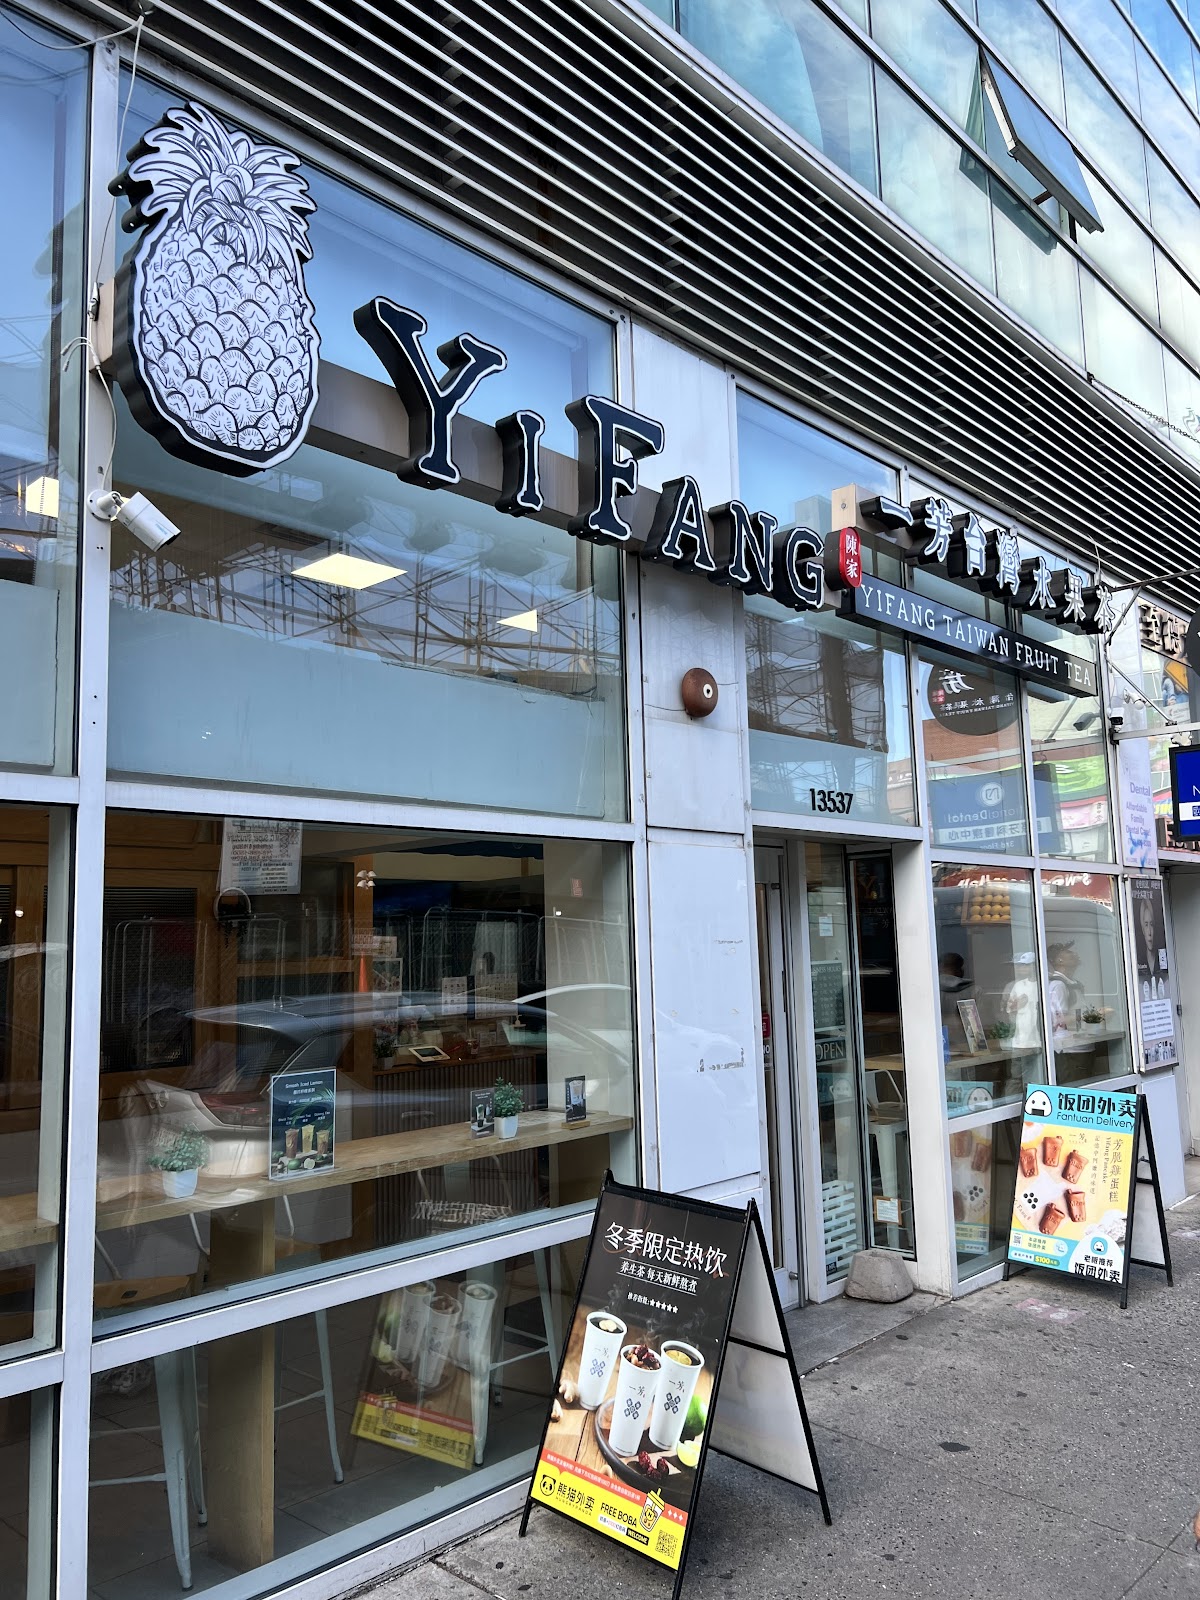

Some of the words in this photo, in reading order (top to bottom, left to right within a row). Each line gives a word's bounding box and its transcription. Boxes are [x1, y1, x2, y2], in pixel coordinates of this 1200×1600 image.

[358, 296, 825, 609] YIFANG
[844, 534, 859, 579] 陳家
[878, 496, 1114, 633] 一芳台灣水果茶
[861, 585, 936, 631] YIFANG
[942, 614, 1011, 658] TAIWAN
[1015, 642, 1059, 675] FRUIT
[1064, 660, 1093, 687] TEA
[809, 788, 854, 815] 13537
[1129, 782, 1151, 797] Dental
[1056, 1111, 1094, 1125] Fantuan
[1096, 1117, 1136, 1131] Delivery
[1057, 1092, 1137, 1119] 饭团外卖
[604, 1221, 728, 1278] 冬季限定热饮
[619, 1260, 646, 1279] 养生茶
[646, 1266, 699, 1294] 每天新鲜熬煮
[1074, 1261, 1121, 1283] 饭团外卖
[556, 1481, 595, 1512] 熊猫外卖
[600, 1502, 618, 1518] FREE
[617, 1510, 637, 1527] BOBA
